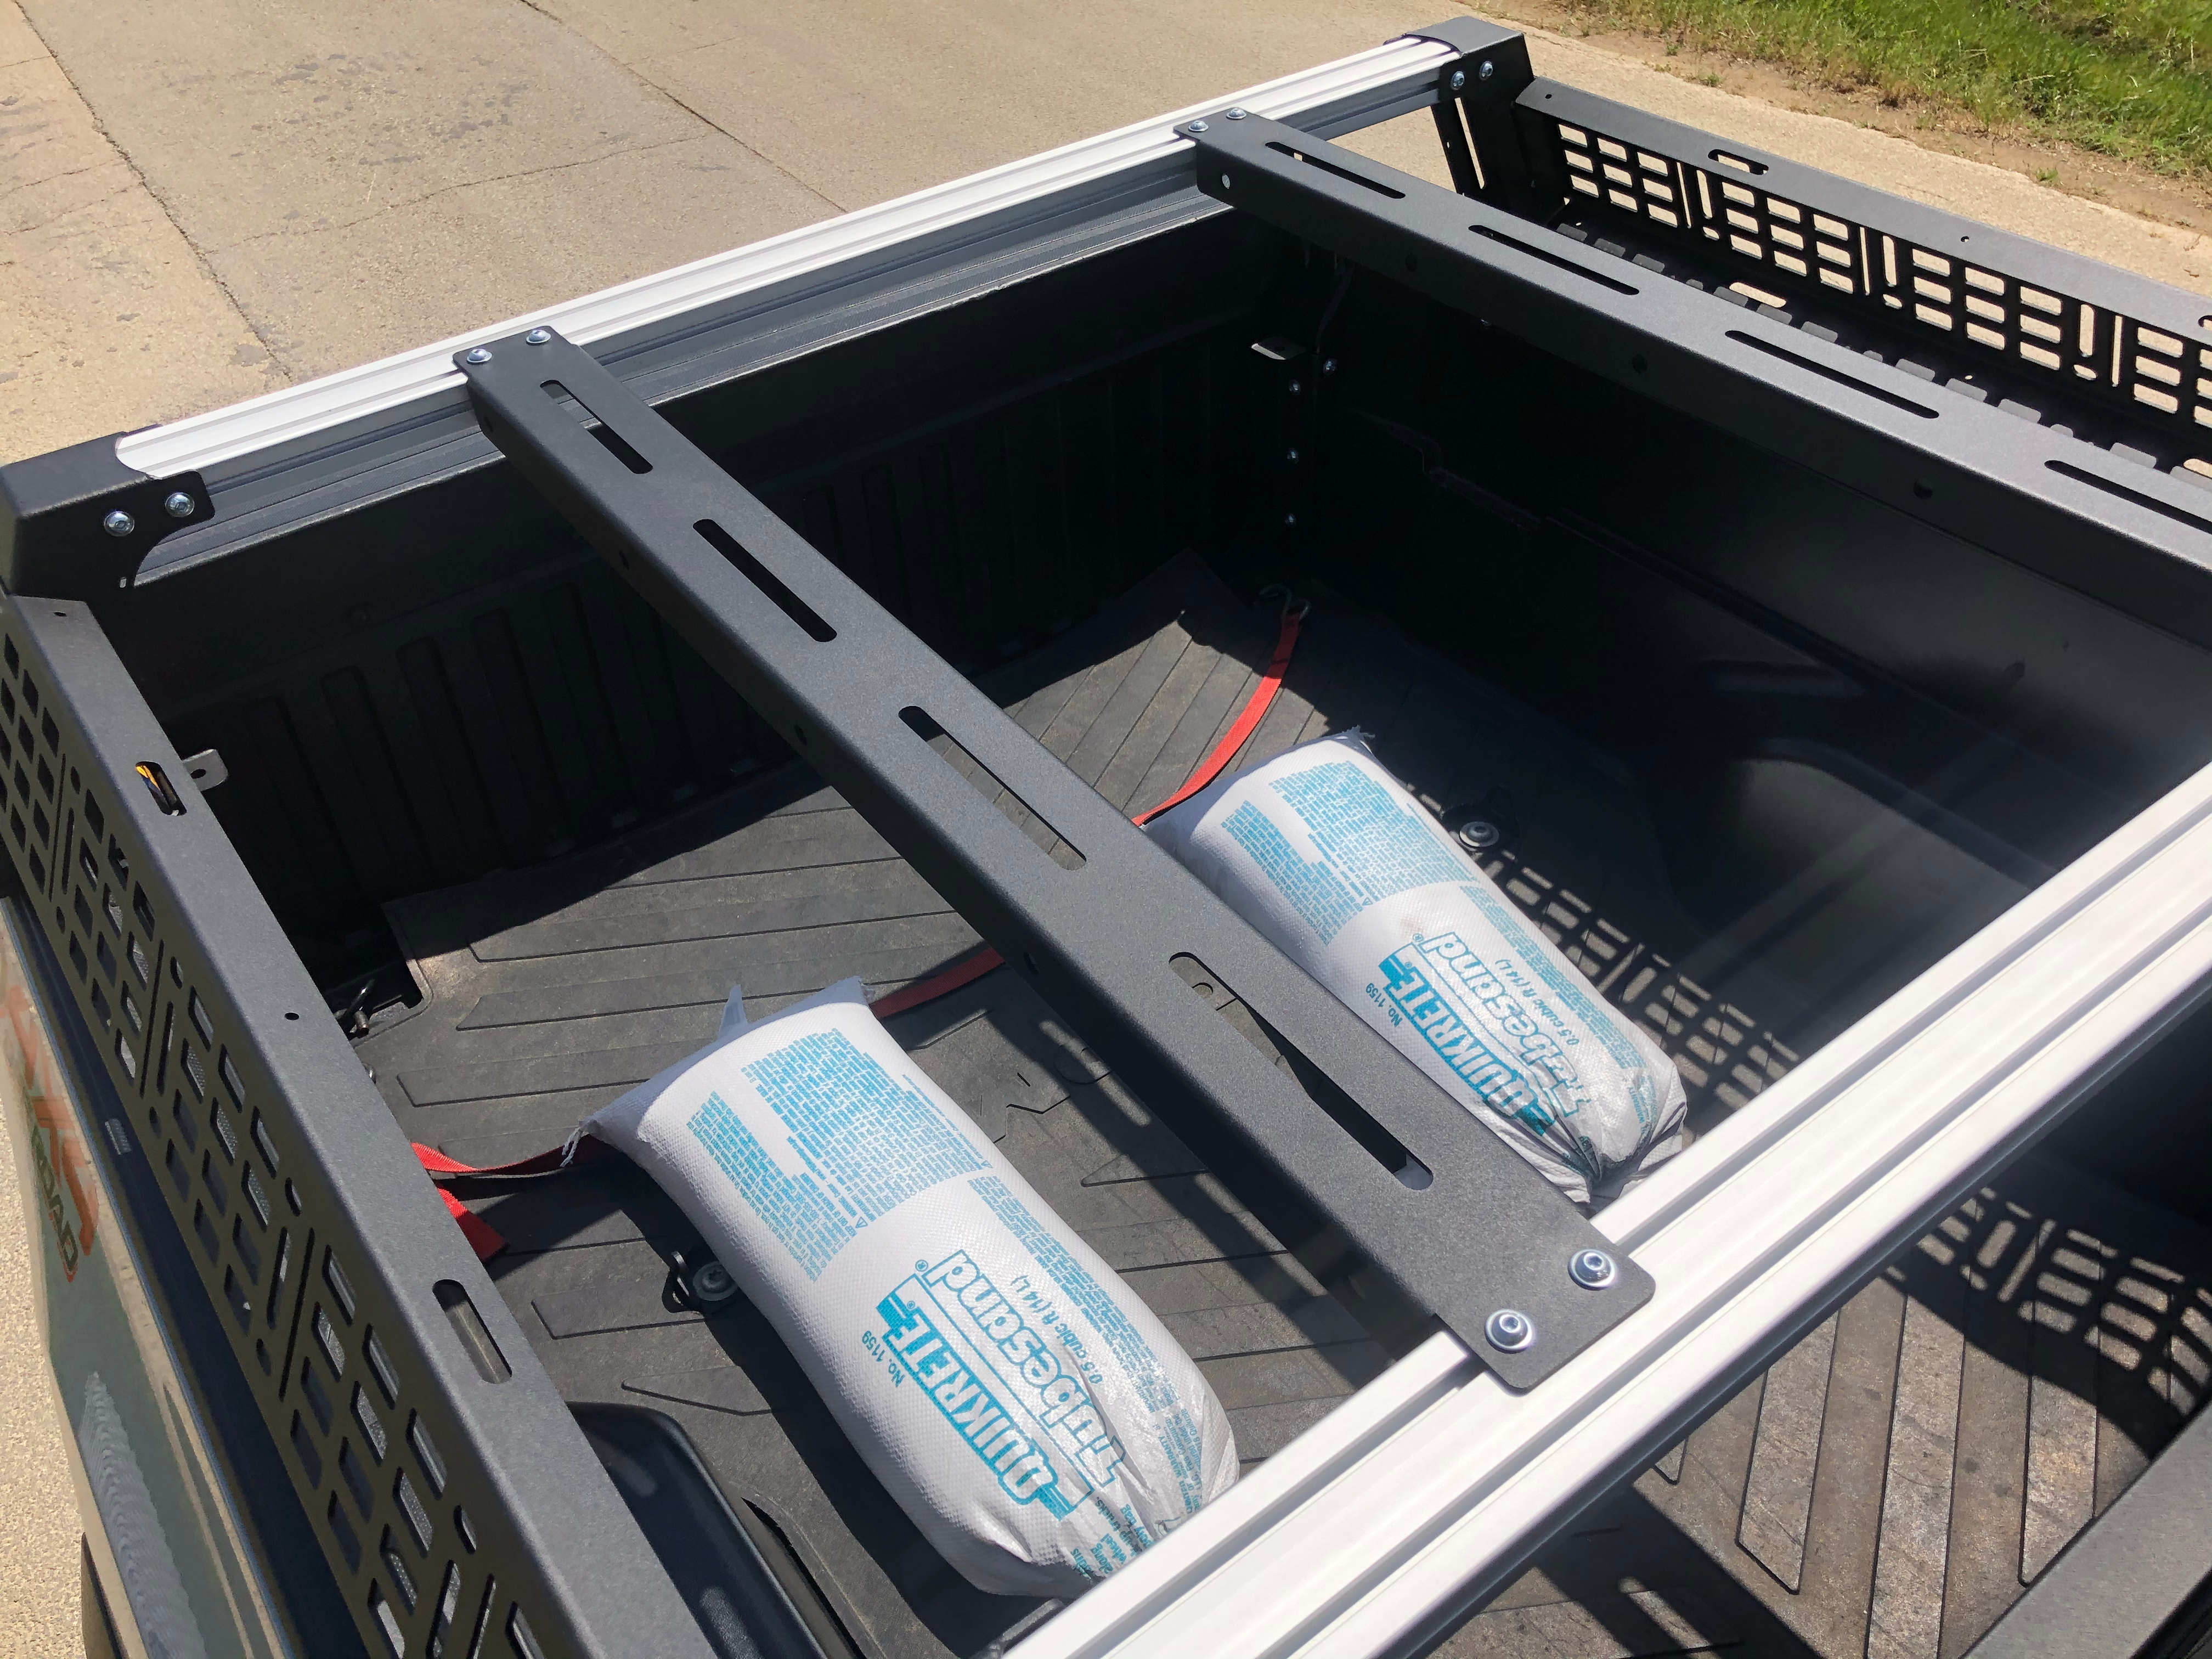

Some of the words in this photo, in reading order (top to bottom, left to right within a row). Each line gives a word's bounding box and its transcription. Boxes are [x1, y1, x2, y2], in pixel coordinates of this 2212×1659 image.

[1495, 957, 1513, 971] L)
[1506, 970, 1530, 988] (14
[1365, 983, 1386, 1008] 1159
[1386, 1007, 1402, 1026] No.
[1533, 998, 1564, 1029] cubic
[1384, 967, 1537, 1116] QUIKRETE
[1558, 1028, 1579, 1046] 0.5
[822, 1197, 834, 1212] REACH
[838, 1217, 847, 1226] OUT
[845, 1226, 856, 1237] KEEP
[1011, 1274, 1031, 1294] L)
[1023, 1288, 1052, 1313] (14
[1042, 1310, 1059, 1327] ft
[861, 1330, 886, 1362] 1159
[1054, 1323, 1087, 1359] cubic
[884, 1359, 905, 1386] No.
[922, 1249, 1128, 1487] Tubesand
[1080, 1361, 1103, 1384] 0.5
[884, 1308, 1058, 1505] QUIKRETE
[1173, 1414, 1182, 1426] the
[1179, 1426, 1192, 1443] under
[1159, 1436, 1182, 1477] WARRANTY
[1094, 1498, 1122, 1532] trucks.
[1090, 1543, 1114, 1575] along
[1100, 1533, 1127, 1564] wheel
